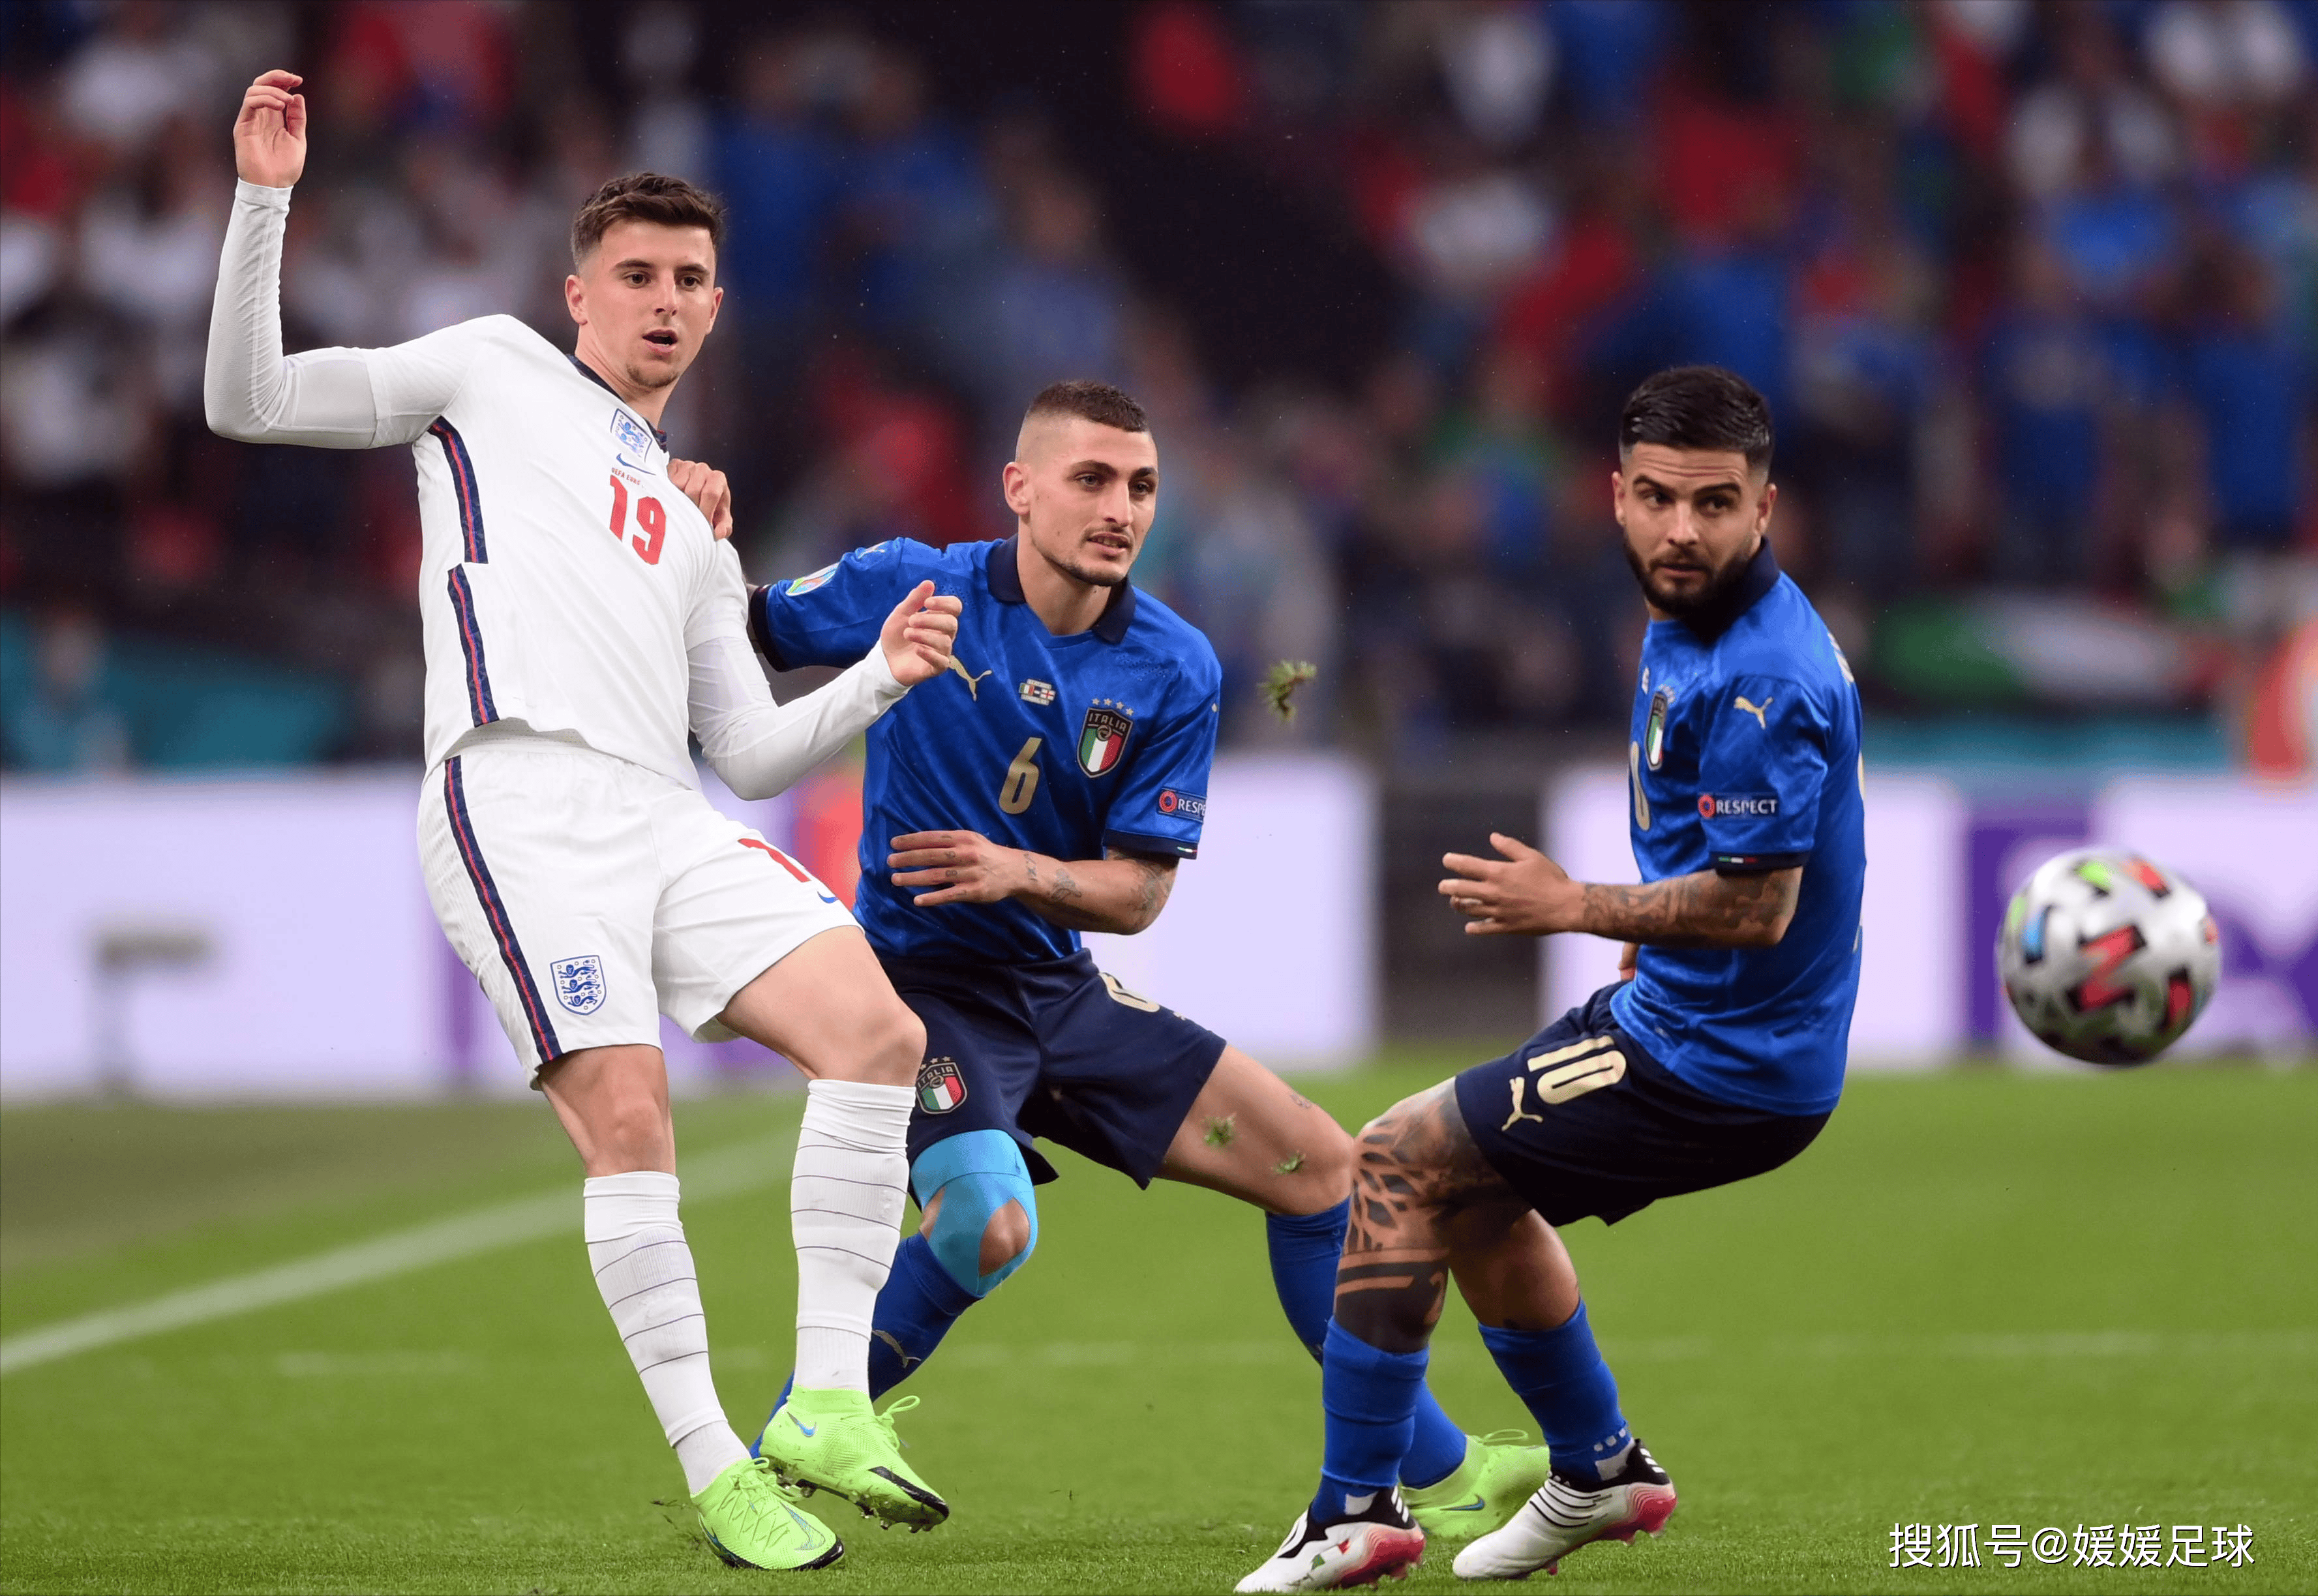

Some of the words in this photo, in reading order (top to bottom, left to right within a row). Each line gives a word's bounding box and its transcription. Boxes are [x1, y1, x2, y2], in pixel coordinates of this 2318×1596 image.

[609, 474, 667, 565] 19
[1089, 712, 1127, 732] ITALIA
[999, 736, 1042, 814] 6
[1715, 798, 1777, 815] RESPECT
[917, 1066, 954, 1088] ITALIA
[1527, 1034, 1627, 1104] 10
